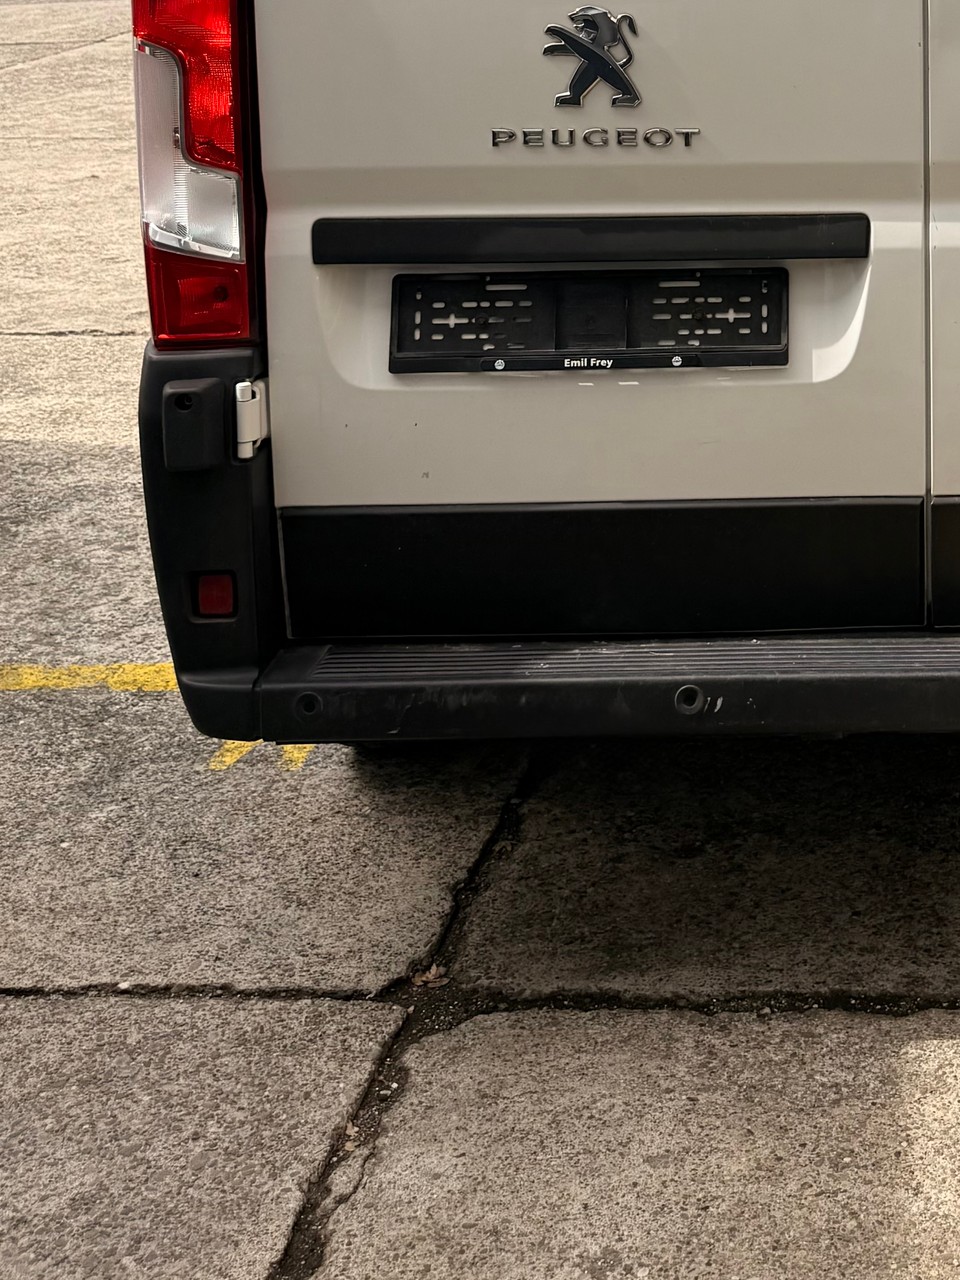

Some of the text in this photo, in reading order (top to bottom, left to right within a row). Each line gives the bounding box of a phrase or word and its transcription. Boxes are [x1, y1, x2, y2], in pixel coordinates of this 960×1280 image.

[491, 127, 701, 147] PEUGEOT
[564, 358, 613, 369] Emil Frey
